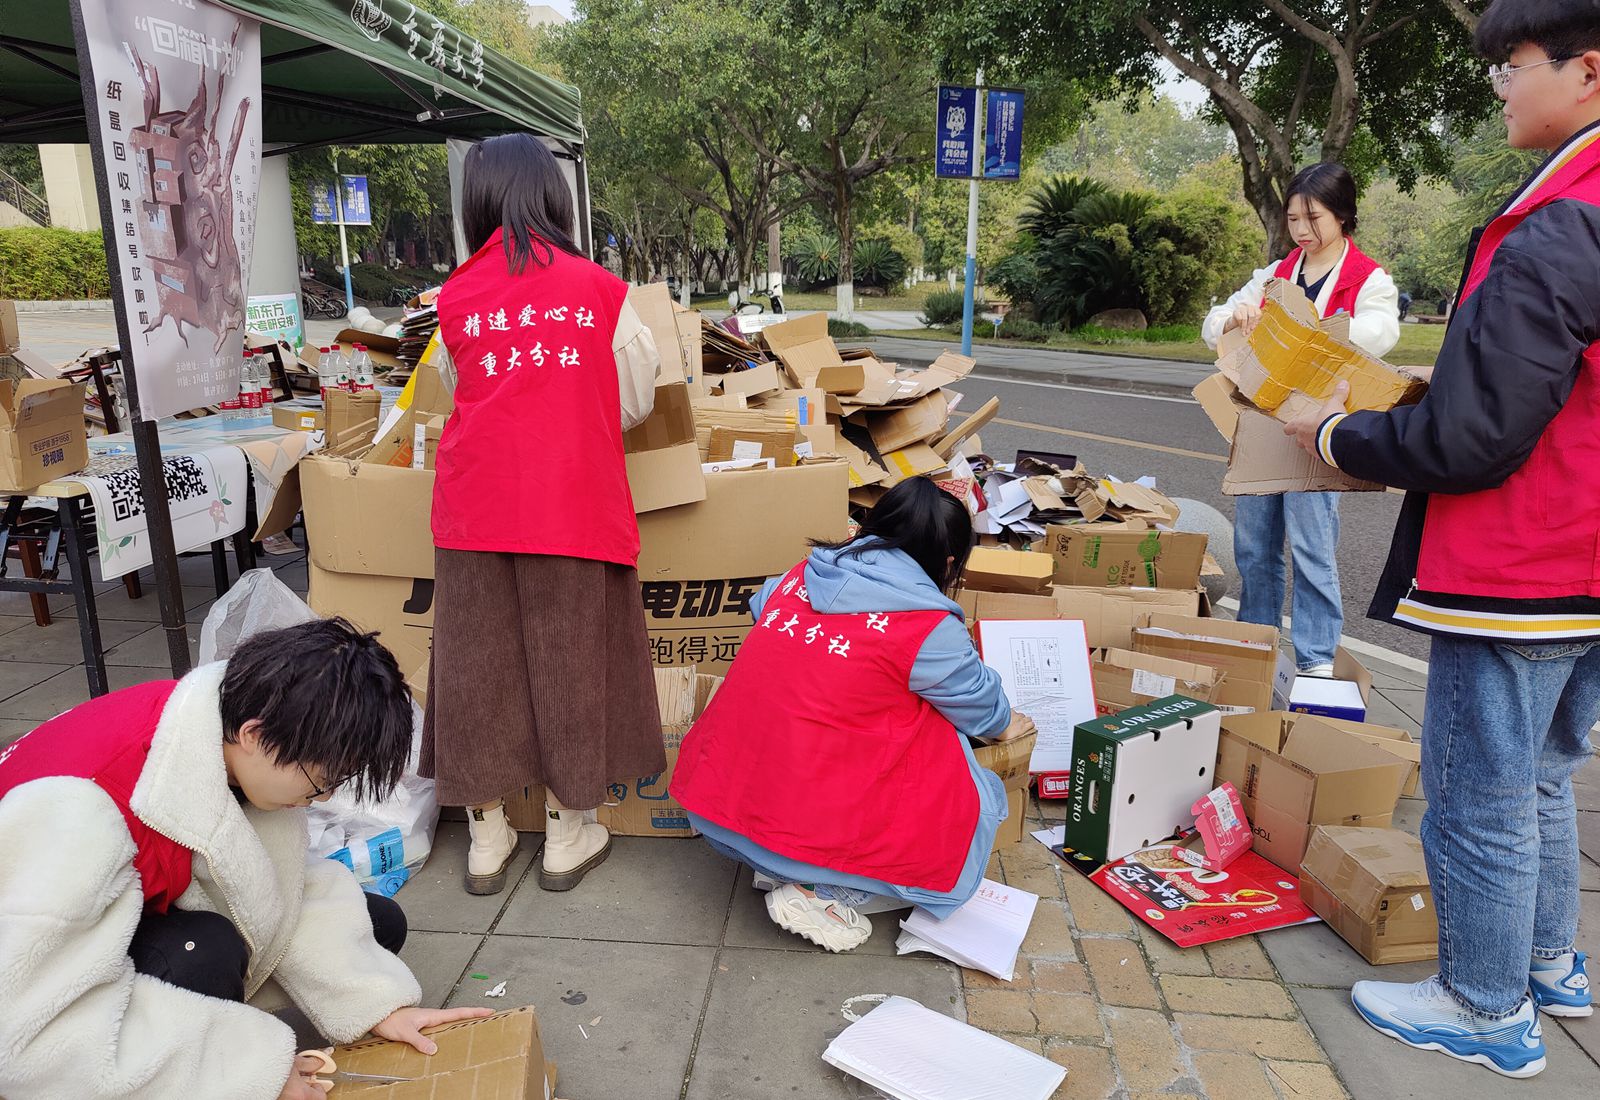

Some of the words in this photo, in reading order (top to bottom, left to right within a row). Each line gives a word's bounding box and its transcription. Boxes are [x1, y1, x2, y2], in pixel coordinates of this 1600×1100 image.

[247, 303, 285, 319] 新东方
[462, 303, 595, 337] 精进爱心社
[479, 341, 581, 377] 重大分社
[641, 578, 755, 619] 电动车
[649, 635, 742, 665] 跑得远
[762, 608, 850, 658] 重大分社
[1121, 699, 1197, 727] ORANGES
[1072, 758, 1086, 822] ORANGES
